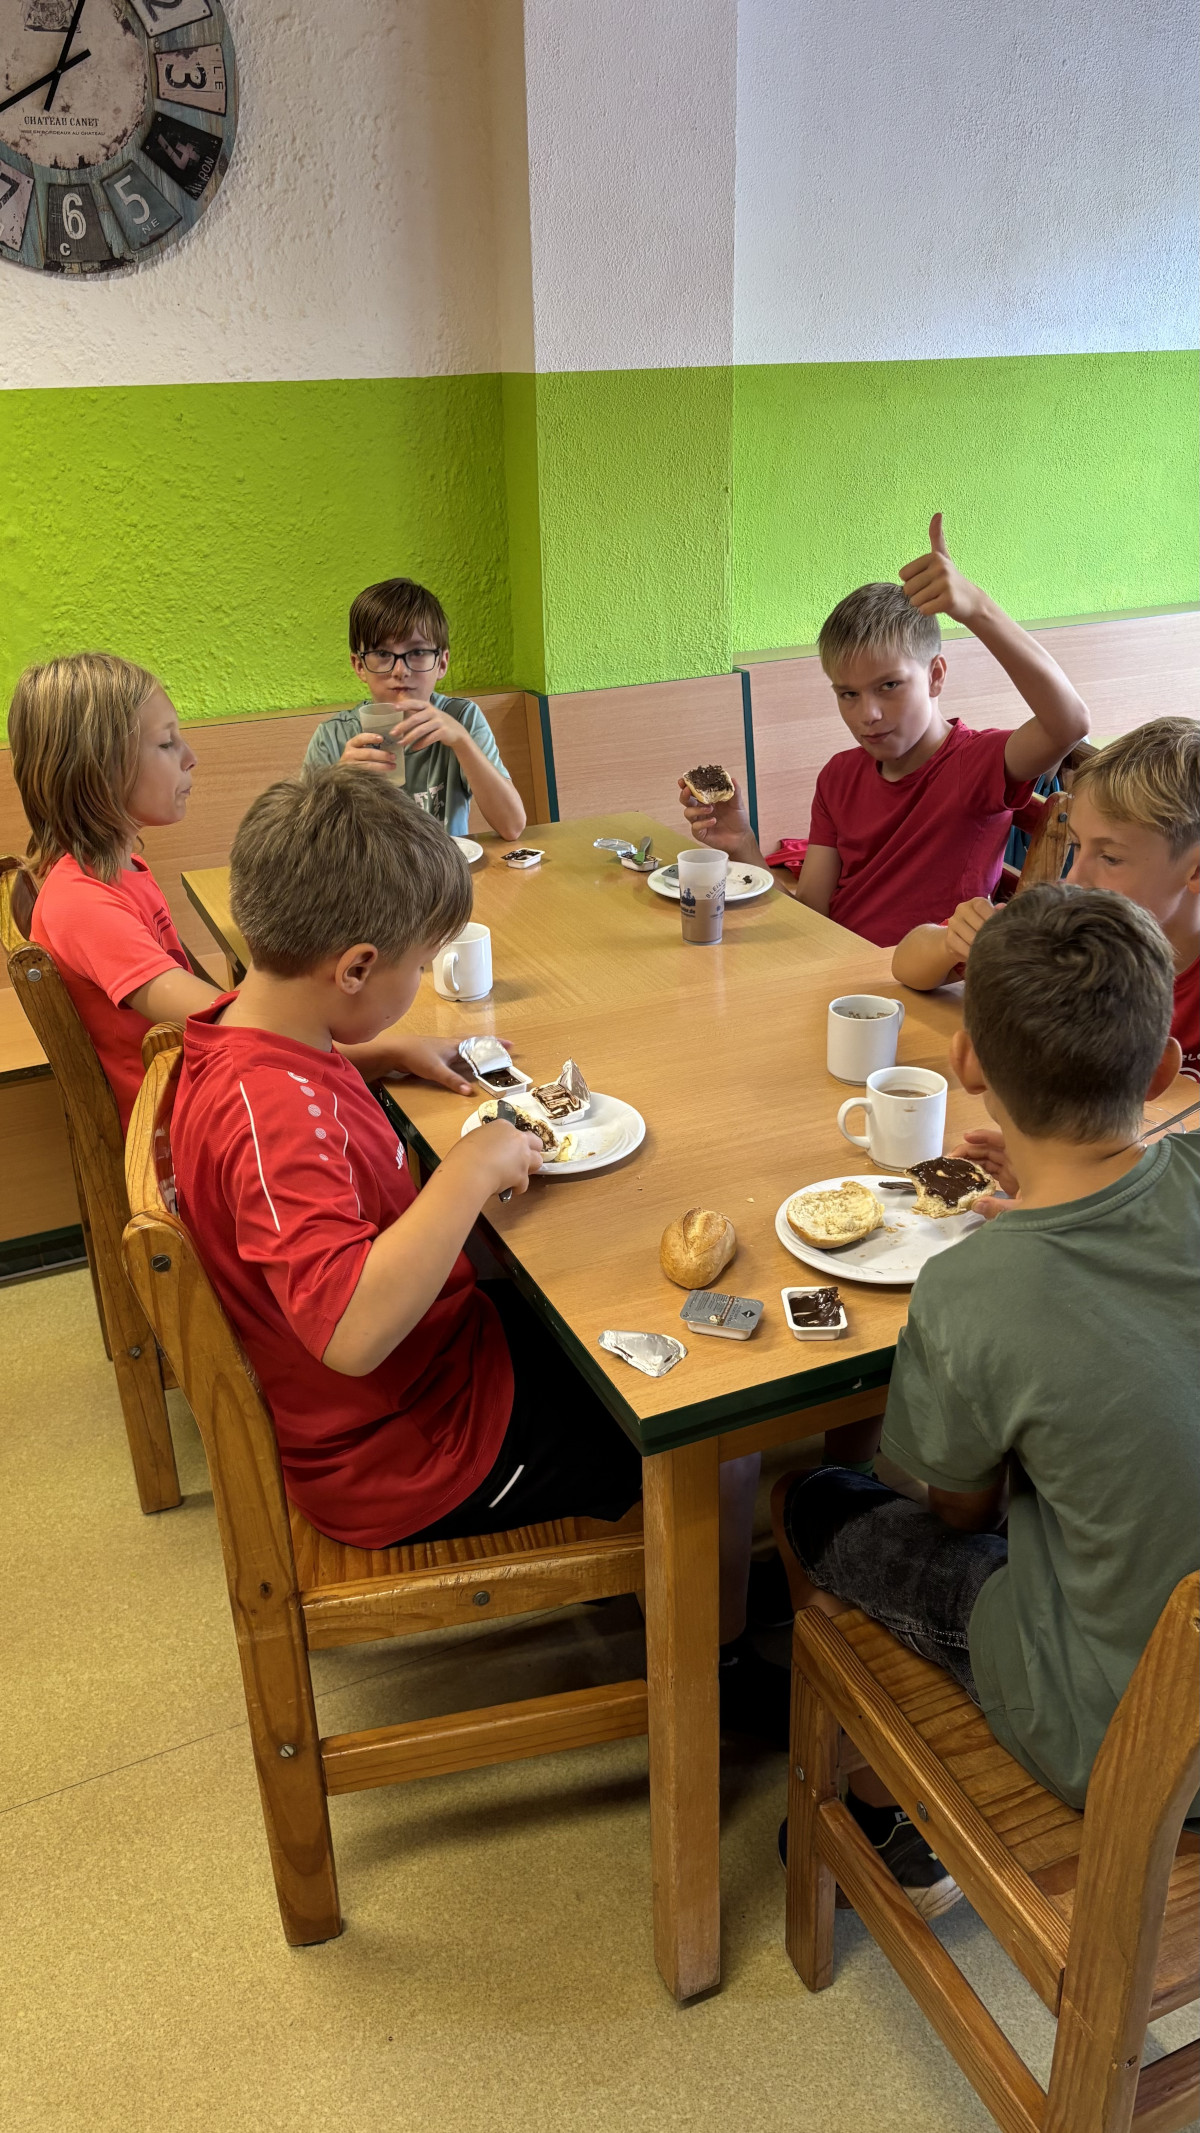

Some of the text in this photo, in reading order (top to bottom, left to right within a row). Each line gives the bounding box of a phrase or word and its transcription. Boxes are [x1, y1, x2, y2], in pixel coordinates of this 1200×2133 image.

[165, 63, 207, 89] 3
[213, 66, 224, 90] LE
[23, 115, 100, 127] CHATEAU CANET
[157, 133, 200, 171] 4
[113, 174, 150, 225] 5
[62, 192, 87, 240] 6
[142, 218, 160, 234] NE
